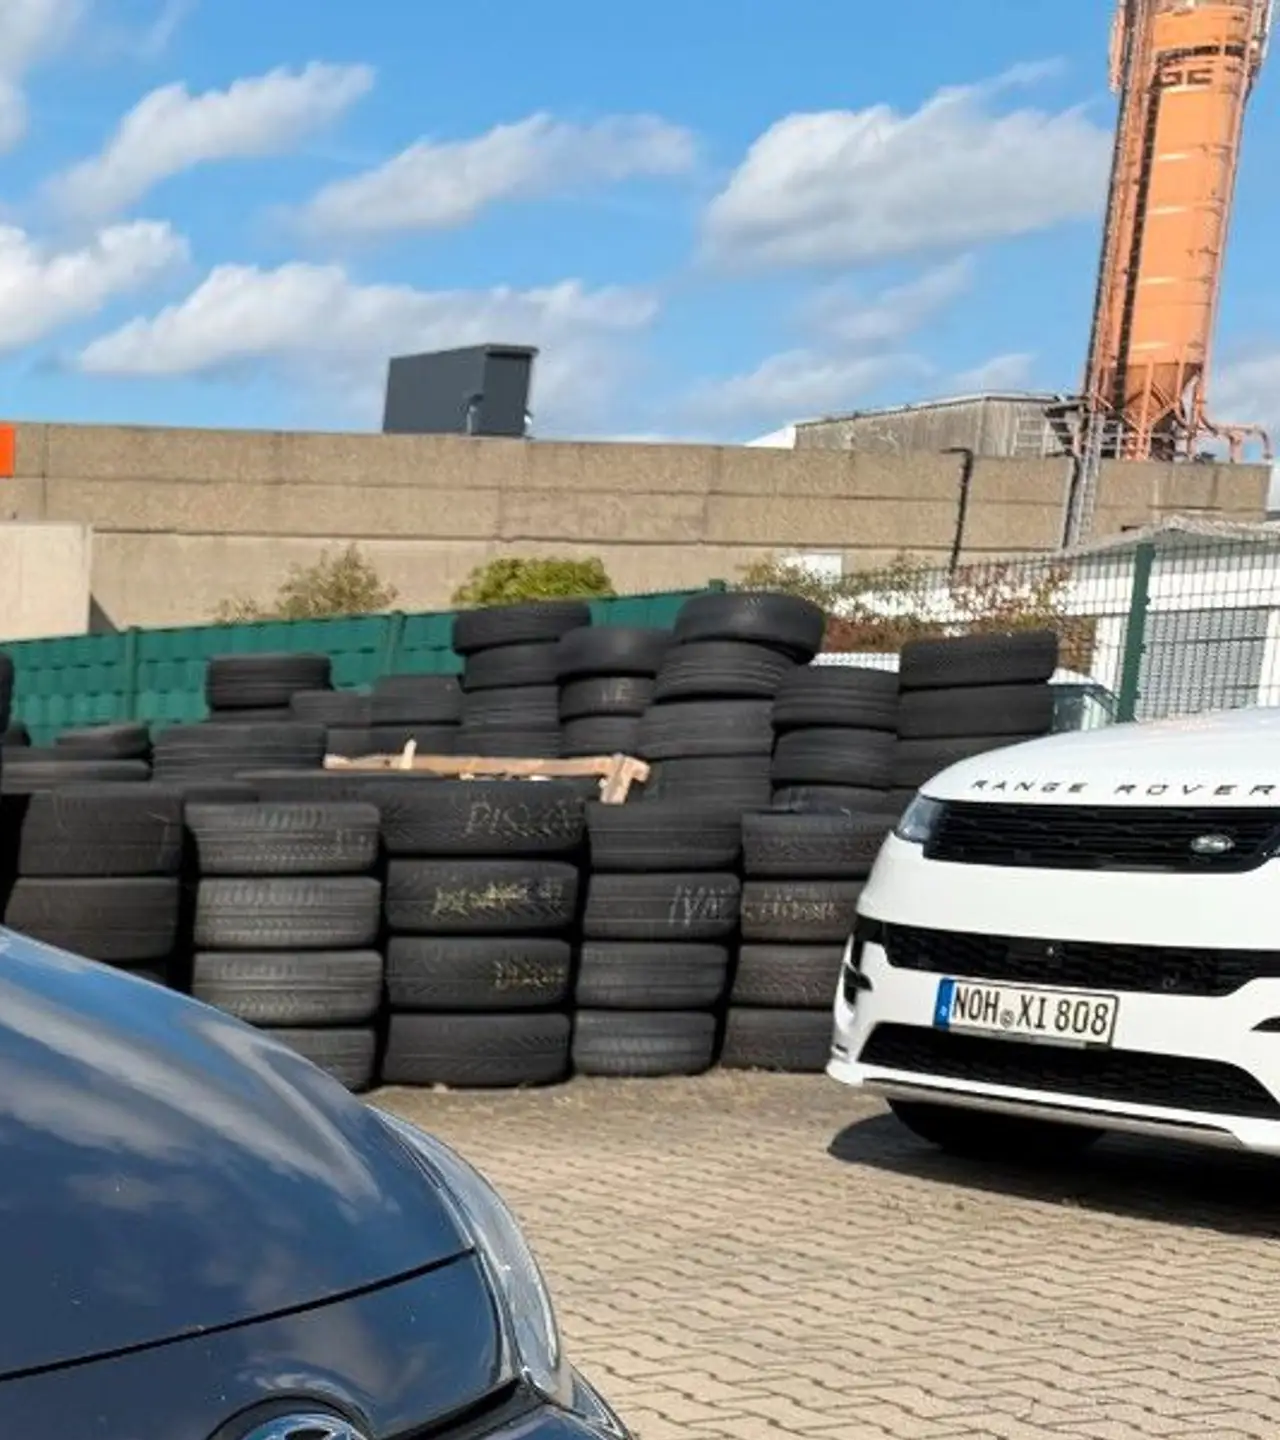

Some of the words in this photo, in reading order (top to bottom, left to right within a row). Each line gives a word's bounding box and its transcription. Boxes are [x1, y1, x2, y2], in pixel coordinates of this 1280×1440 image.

[971, 779, 1088, 794] RANGE
[1113, 783, 1277, 796] ROVER
[953, 986, 1001, 1023] NOH
[1016, 993, 1046, 1030] XI
[1054, 998, 1109, 1036] 808
